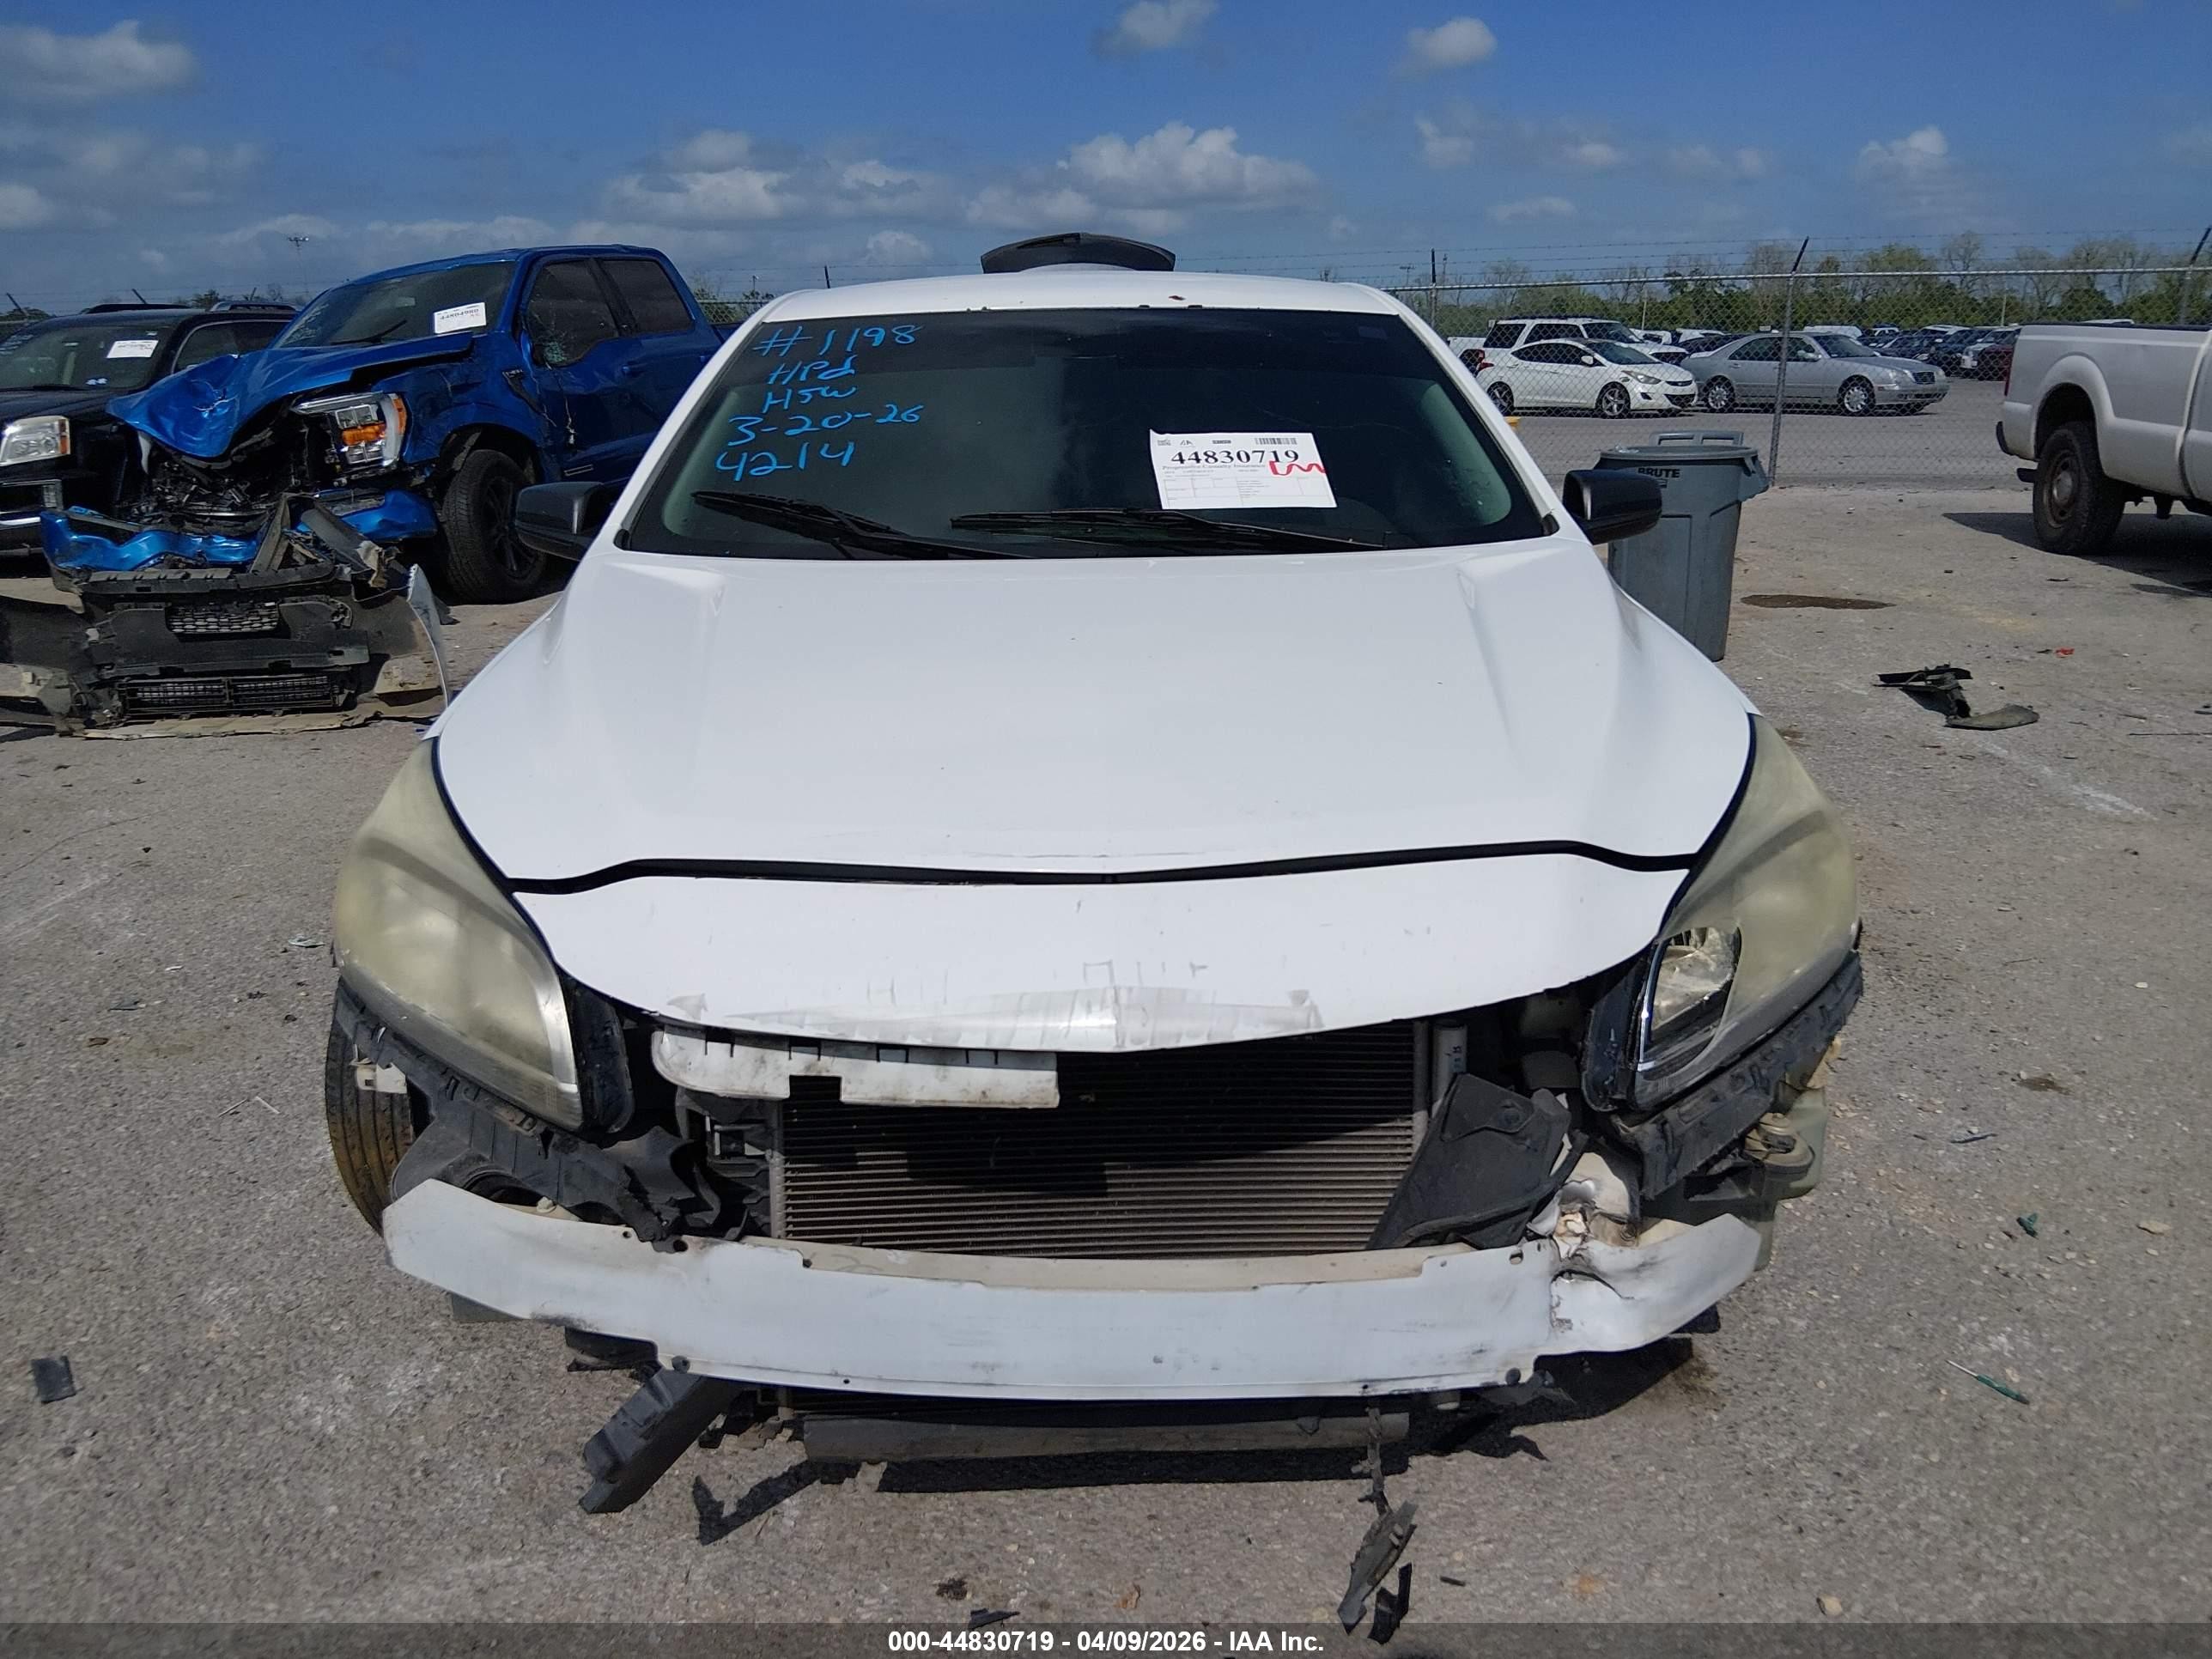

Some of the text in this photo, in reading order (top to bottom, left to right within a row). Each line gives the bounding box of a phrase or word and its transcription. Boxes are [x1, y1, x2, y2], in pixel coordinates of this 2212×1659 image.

[728, 404, 924, 446] 3-20-26
[715, 441, 855, 481] 4214
[1171, 449, 1299, 465] 44830719
[1638, 467, 1680, 478] BRUTE
